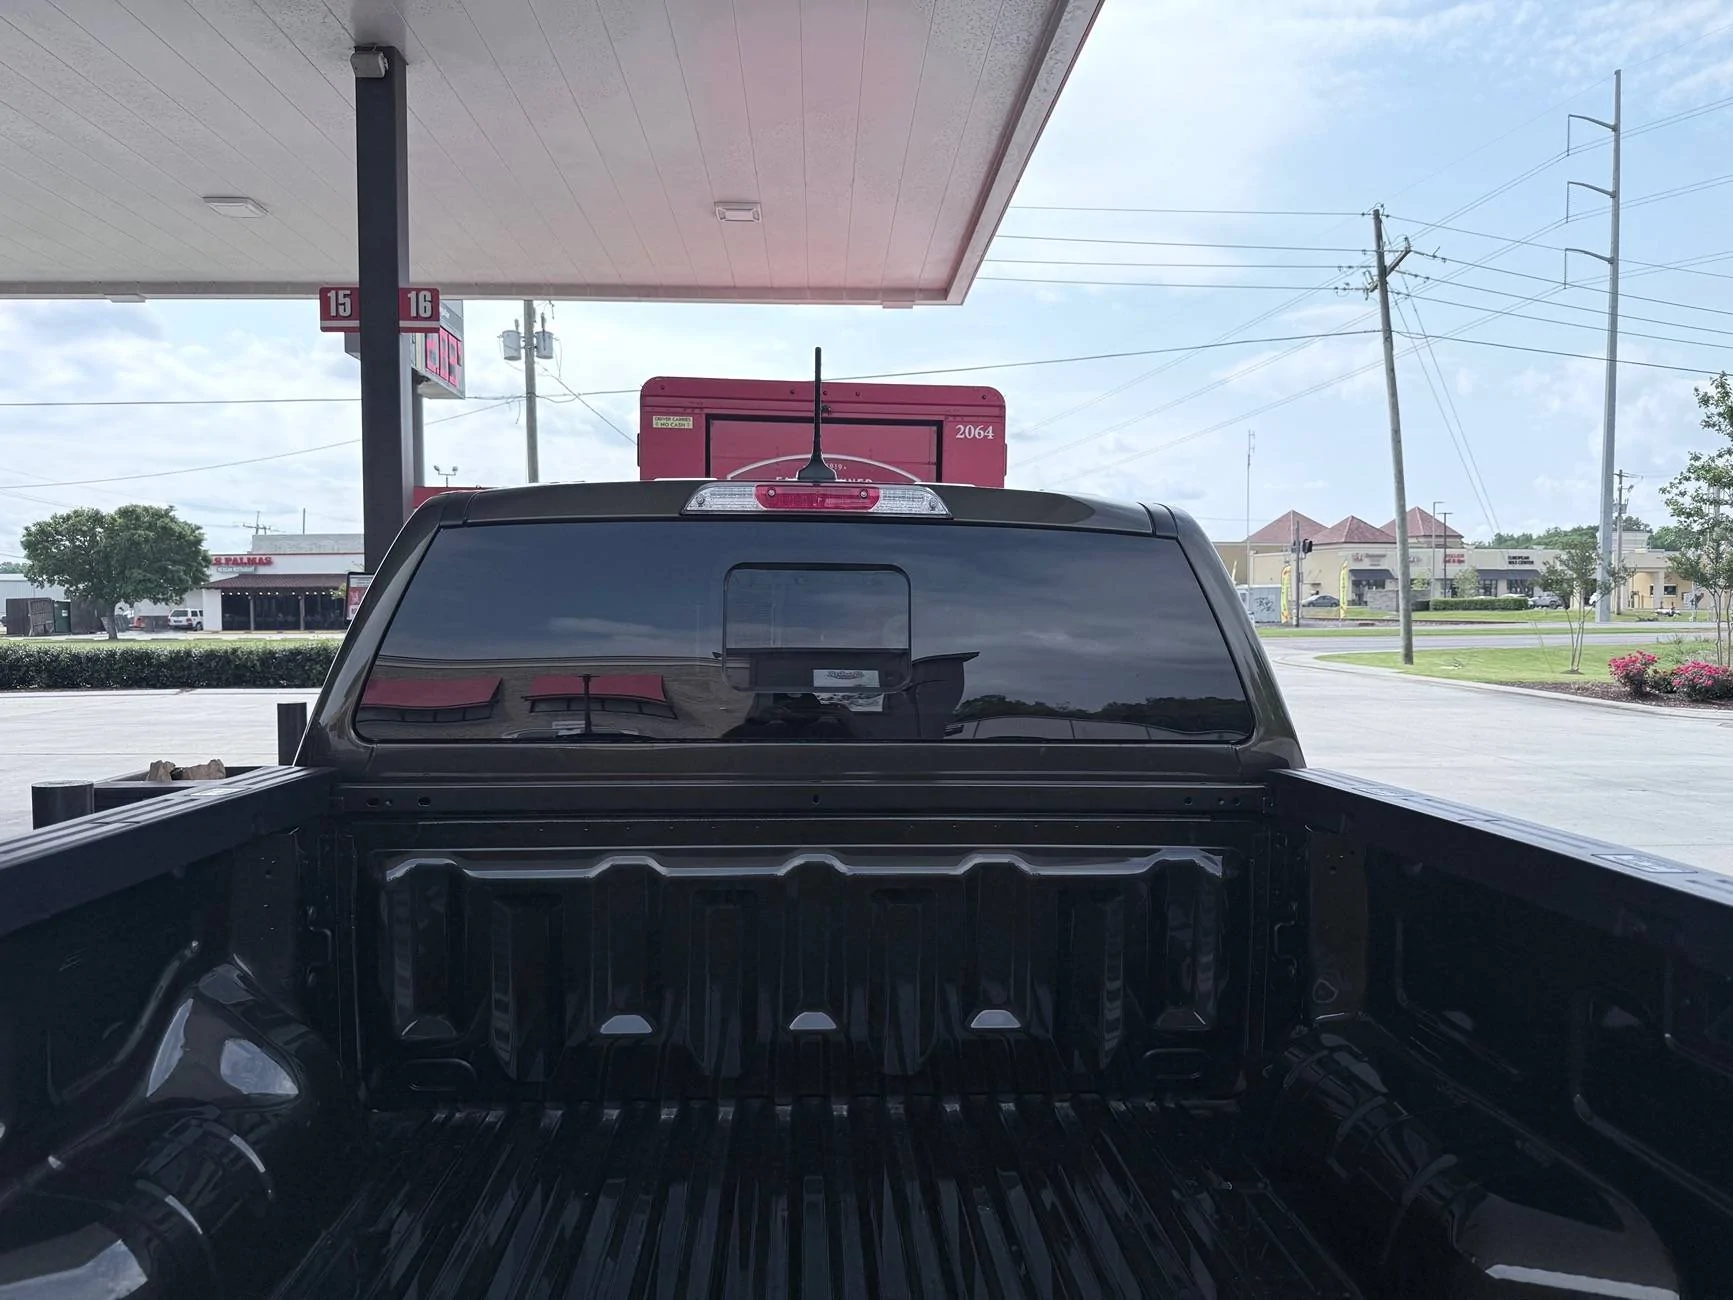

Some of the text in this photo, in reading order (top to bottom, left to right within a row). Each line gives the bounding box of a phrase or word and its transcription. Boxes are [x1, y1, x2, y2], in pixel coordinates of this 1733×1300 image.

[327, 290, 351, 317] 15
[408, 290, 433, 318] 16
[955, 424, 994, 439] 2064
[224, 557, 274, 566] PALMAS
